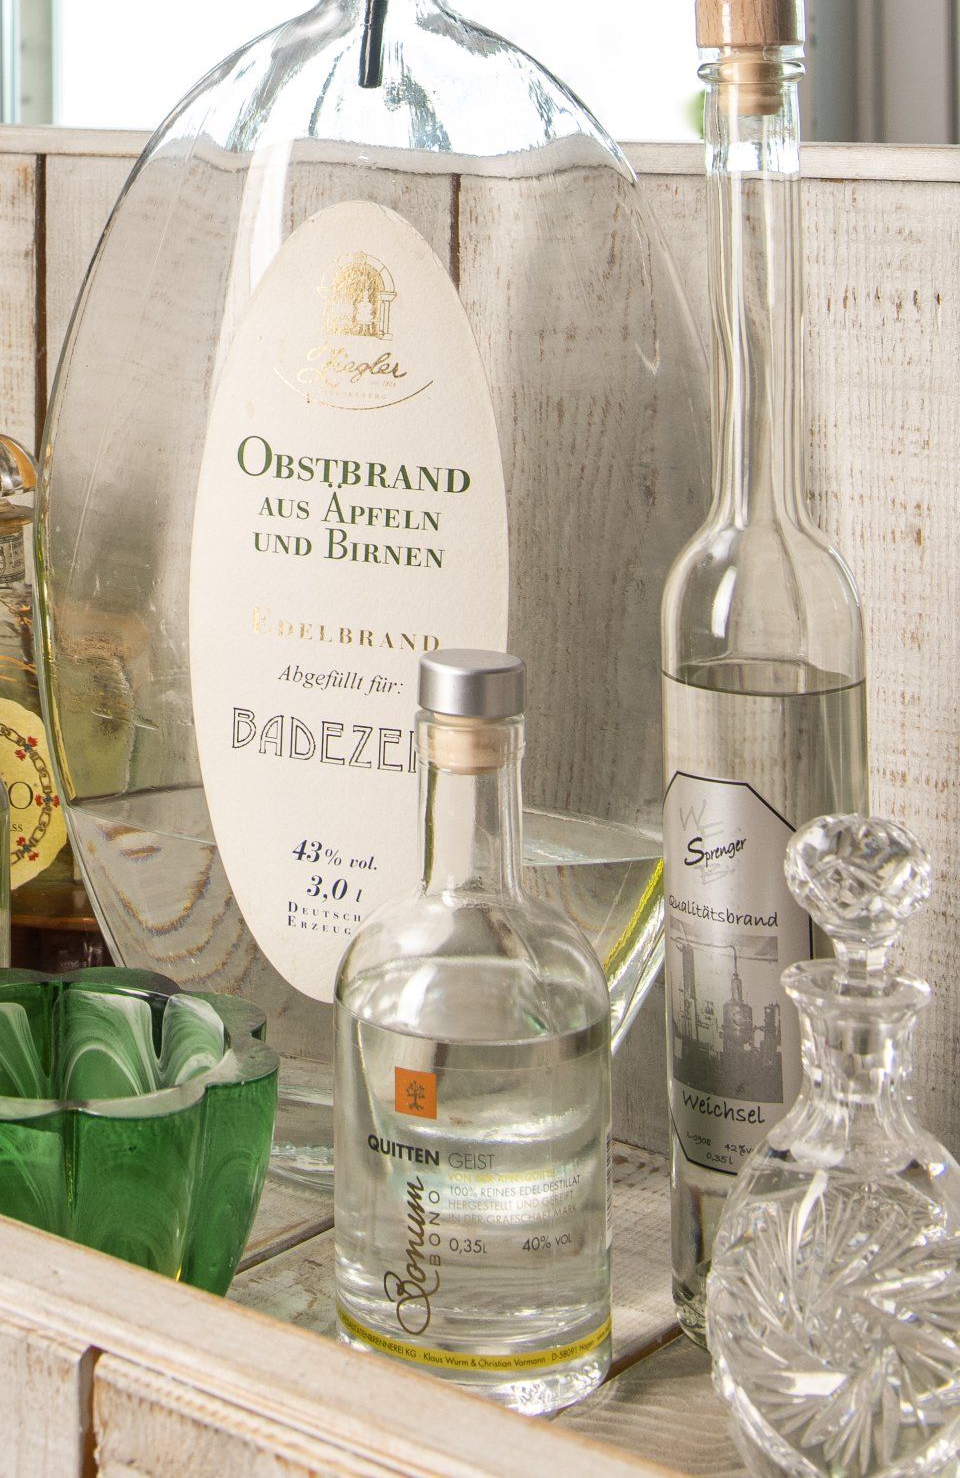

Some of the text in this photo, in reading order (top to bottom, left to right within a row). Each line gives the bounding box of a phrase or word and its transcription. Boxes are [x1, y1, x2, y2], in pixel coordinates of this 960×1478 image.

[236, 435, 472, 494] OBSTBRAND
[257, 482, 443, 532] AUS ÄPFELN
[252, 527, 446, 569] UND BIRNEN
[251, 605, 441, 652] EDELBRAND
[277, 664, 405, 696] Abgefüllt für:
[349, 855, 378, 871] vol.
[683, 836, 747, 868] Sprenger
[306, 874, 348, 903] 3,0
[287, 914, 352, 935] ERZEUG
[668, 894, 779, 928] Qualitätsbrand
[682, 1089, 766, 1125] Weichsel
[367, 1133, 496, 1170] QUITTEN GEIST
[449, 1185, 478, 1198] 100%
[480, 1187, 518, 1198] REINES
[428, 1189, 441, 1267] BONO
[521, 1235, 552, 1251] 40%
[423, 1350, 444, 1363] Klaus
[445, 1356, 469, 1367] Wurm
